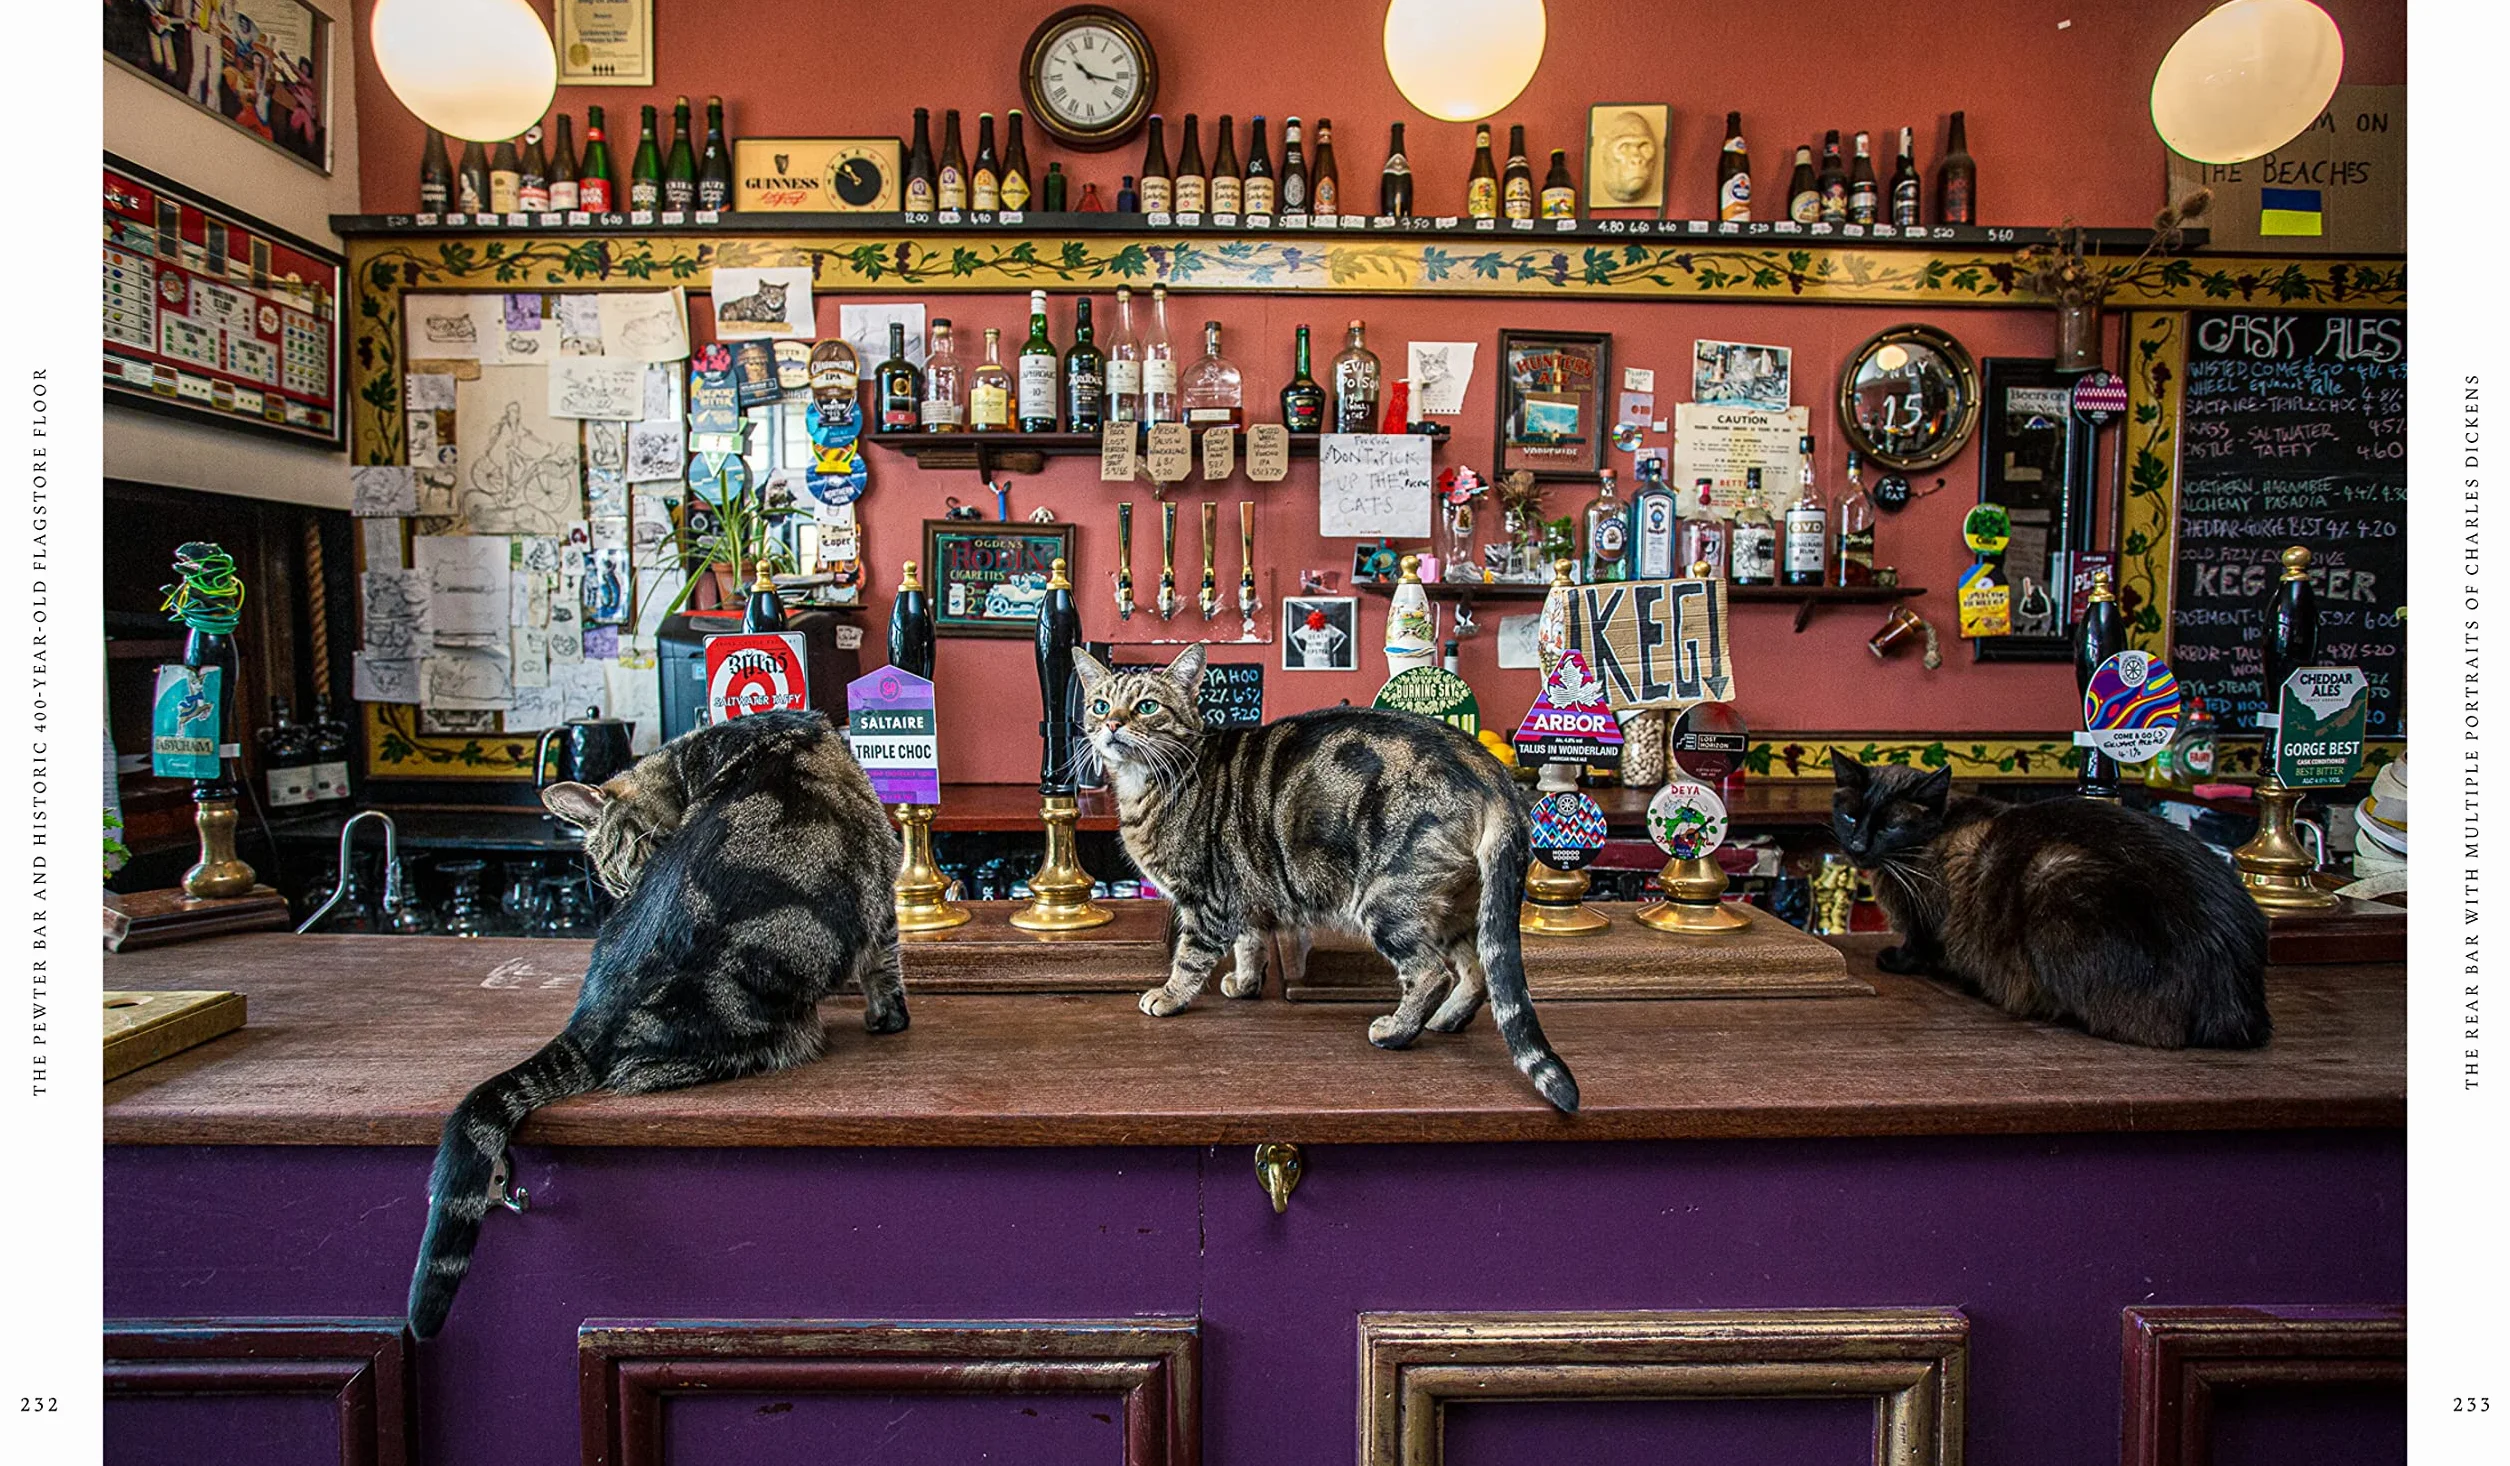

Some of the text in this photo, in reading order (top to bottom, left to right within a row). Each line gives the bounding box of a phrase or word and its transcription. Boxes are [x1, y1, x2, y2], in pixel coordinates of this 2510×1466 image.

[2356, 112, 2389, 133] ON
[2200, 152, 2372, 186] THE BEACHES
[745, 177, 820, 190] GUINNESS
[1401, 217, 1430, 229] 7.50
[2198, 315, 2405, 363] CASK ALES
[1515, 353, 1592, 378] HUNTERS
[2251, 360, 2302, 378] COME
[2317, 362, 2344, 378] GO
[1717, 414, 1768, 425] CAUTION
[1882, 393, 1924, 433] 15
[2253, 442, 2318, 458] TAFFY
[2357, 442, 2404, 459] 4.60
[1336, 472, 1402, 491] UP THE
[1338, 496, 1394, 516] CATS
[2357, 520, 2397, 539] 4.20
[951, 548, 1046, 571] ROBIN
[949, 569, 1005, 581] CIGARETTES
[2193, 564, 2377, 604] KEG EER
[1584, 580, 1705, 706] KEG
[2299, 673, 2353, 685] CHEDDAR
[1396, 683, 1457, 698] BURNING SKY
[2311, 685, 2341, 697] ALES
[713, 693, 803, 708] SALTWATER TAFFY
[1229, 707, 1261, 722] 7.20
[860, 716, 925, 730] SALTAIRE
[1532, 713, 1607, 733] ARBOR
[2113, 732, 2134, 741] COME
[855, 744, 933, 760] TRIPLE CHOC
[1518, 744, 1619, 757] TALUS IN WONDERLAND
[2284, 741, 2360, 757] GORGE BEST
[2295, 766, 2345, 777] BEST BITTER
[1670, 784, 1701, 796] DEYA
